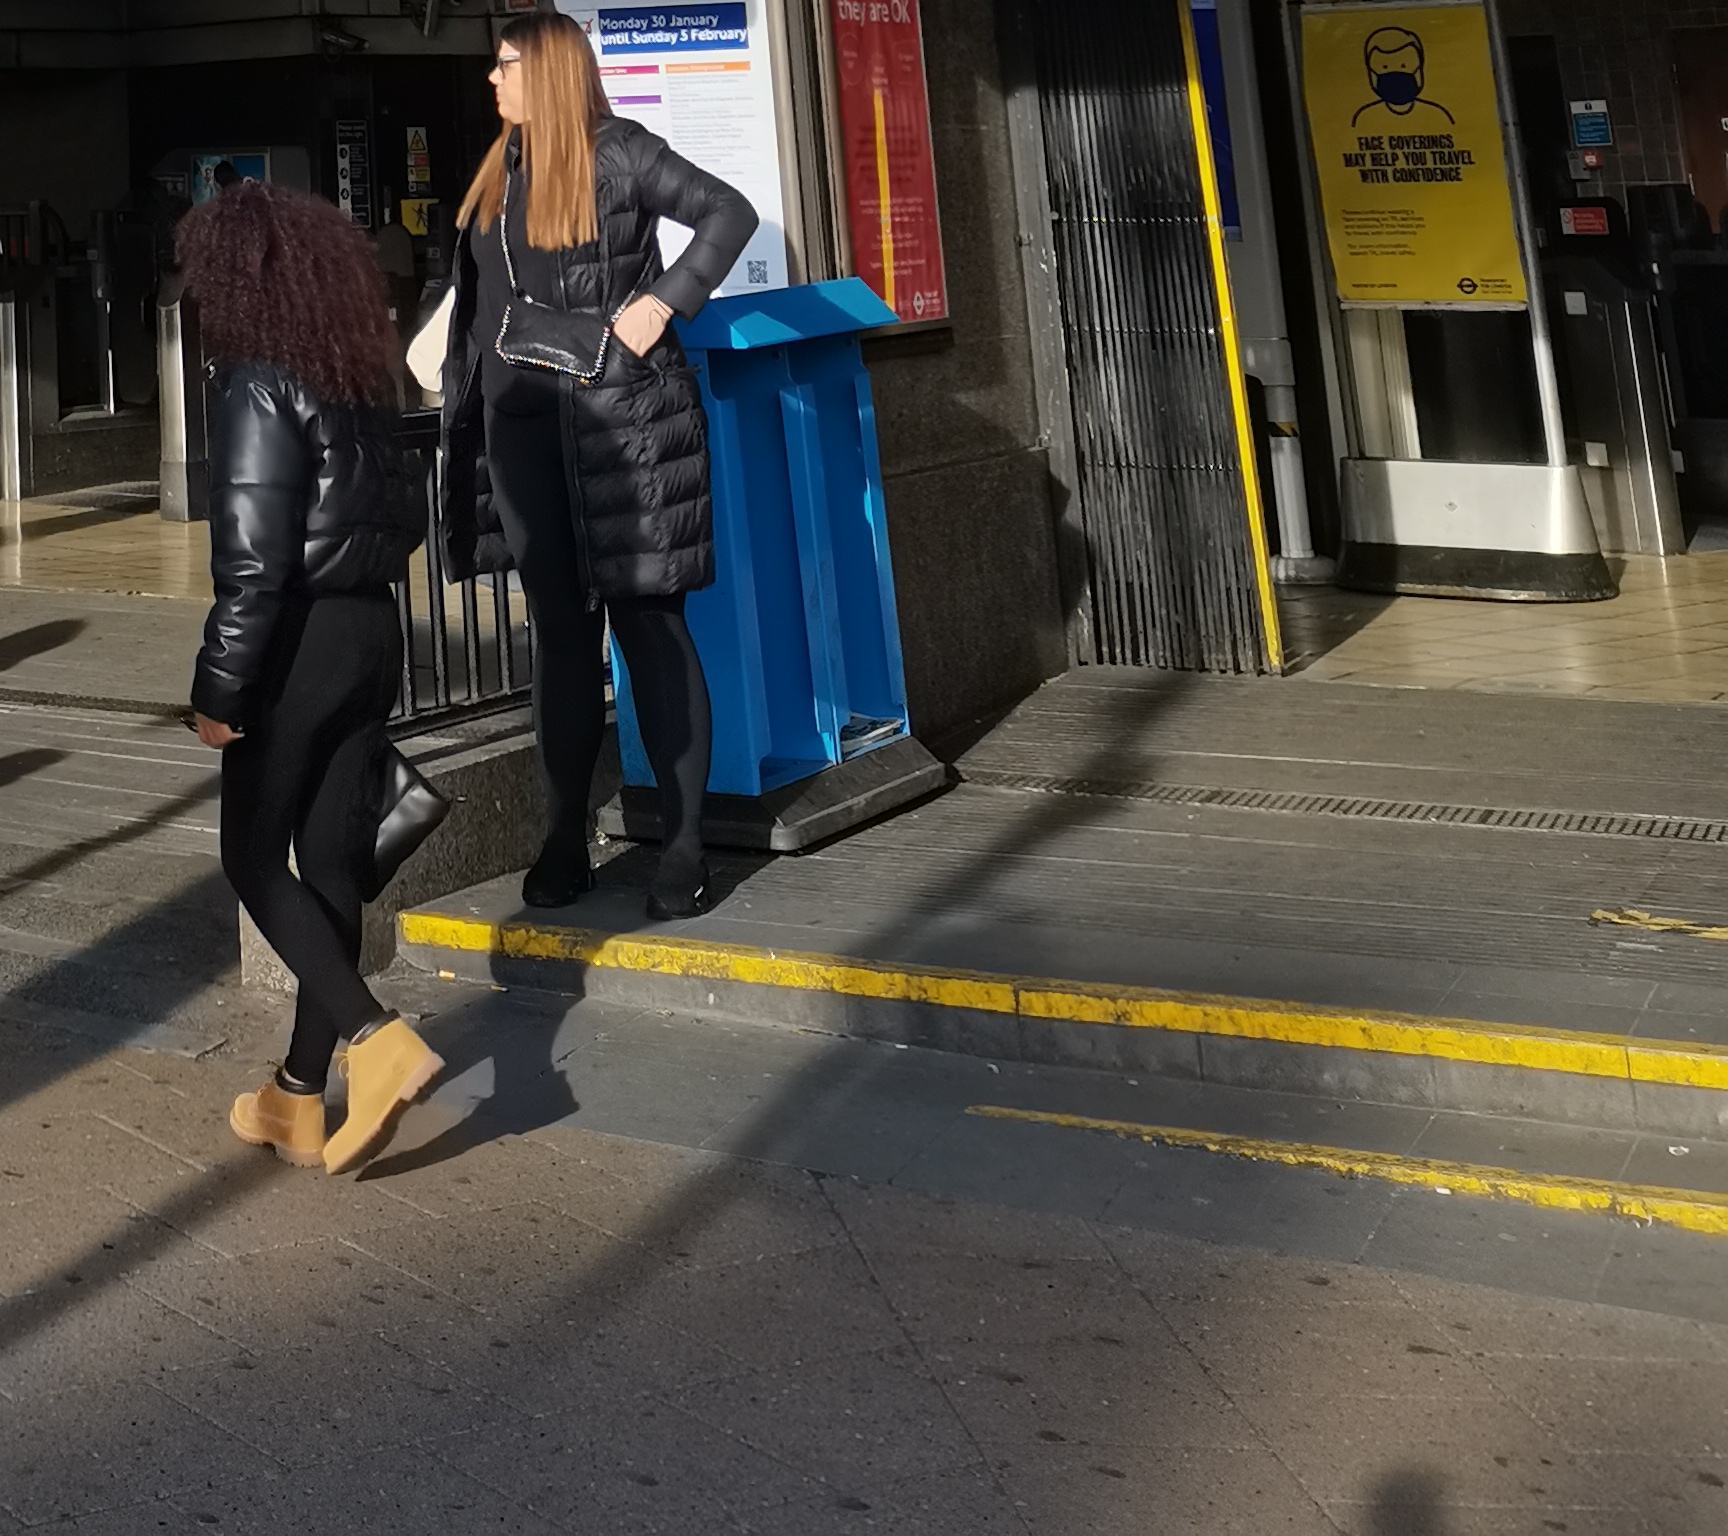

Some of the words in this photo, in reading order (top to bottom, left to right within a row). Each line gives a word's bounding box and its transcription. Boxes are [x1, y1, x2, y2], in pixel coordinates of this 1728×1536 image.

[869, 1, 891, 22] are
[600, 16, 648, 31] Monday
[651, 14, 667, 28] 30
[669, 13, 720, 28] January
[601, 31, 631, 46] until
[631, 30, 678, 45] Sunday
[679, 29, 689, 42] 5
[690, 27, 748, 43] February
[1357, 136, 1385, 152] FACE
[1388, 134, 1455, 151] COVERINGS
[1342, 153, 1367, 168] MAY
[1369, 152, 1400, 167] HELP
[1402, 151, 1428, 166] YOU
[1430, 150, 1476, 165] TRAVEL
[1358, 168, 1390, 184] WITH
[1392, 167, 1464, 183] CONFIDENCE
